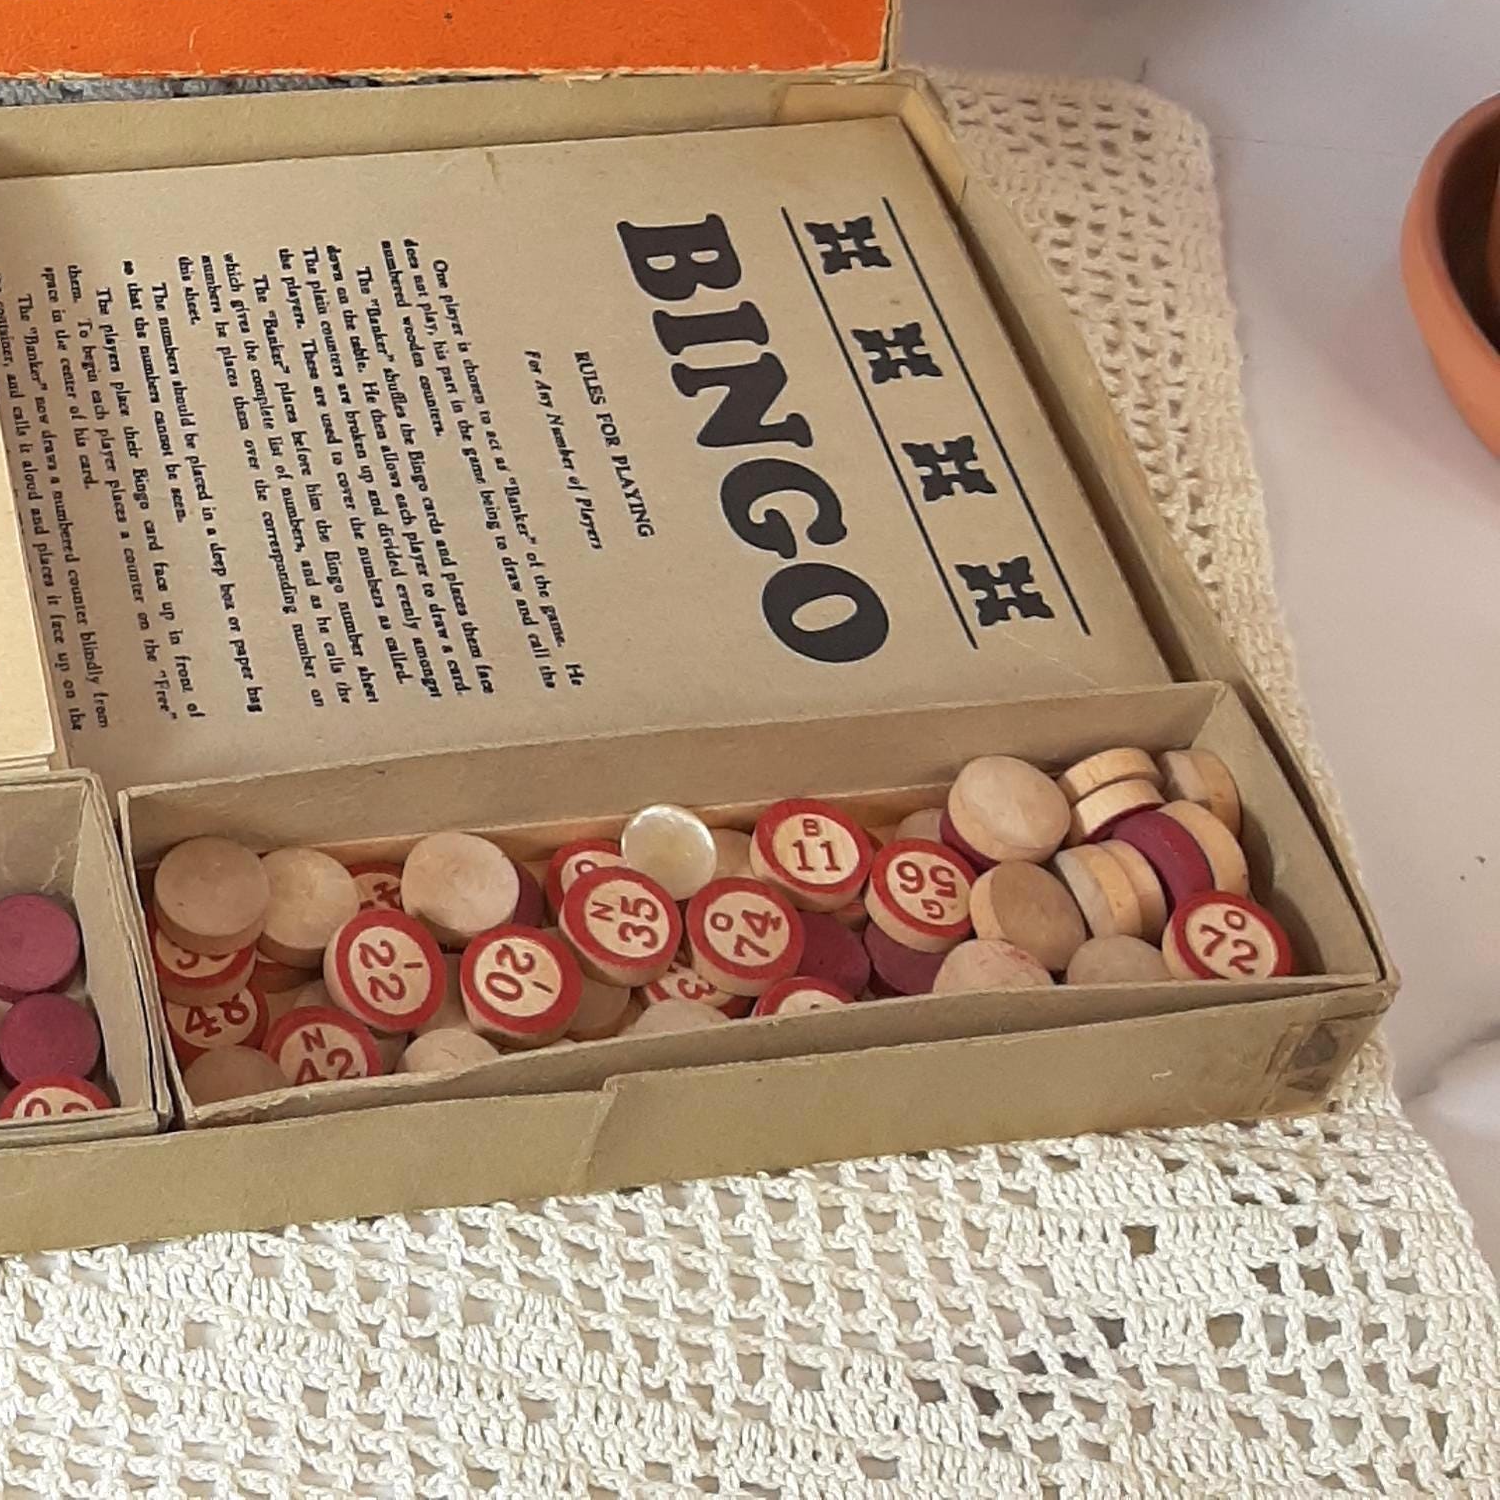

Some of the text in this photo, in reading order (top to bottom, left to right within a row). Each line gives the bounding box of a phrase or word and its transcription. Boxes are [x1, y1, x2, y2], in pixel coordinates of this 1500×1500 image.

[354, 264, 374, 295] The
[431, 258, 449, 289] One
[437, 293, 464, 336] player
[401, 314, 426, 368] wooden
[431, 339, 450, 361] his
[381, 366, 408, 419] shuffles
[436, 364, 458, 394] part
[461, 358, 485, 405] chosen
[449, 398, 466, 414] in
[478, 409, 492, 425] to
[398, 422, 416, 446] the
[455, 418, 475, 442] the
[484, 429, 503, 451] act
[573, 350, 656, 538] RULES FOR PLAYING
[616, 213, 889, 663] BINGO
[461, 446, 487, 485] game
[523, 349, 603, 550] For Any Number of Players
[406, 449, 429, 492] Bingo
[94, 286, 206, 718] The players place their Bingo card face up in front of
[420, 495, 446, 535] cards
[478, 488, 501, 530] being
[434, 538, 458, 567] and
[493, 534, 508, 551] to
[524, 551, 546, 568] of
[500, 555, 523, 592] draw
[532, 573, 552, 598] the
[440, 571, 469, 617] places
[514, 597, 540, 626] and
[459, 620, 483, 659] them
[526, 632, 551, 659] call
[473, 663, 495, 694] face
[537, 664, 557, 689] the
[563, 663, 586, 686] He
[802, 818, 823, 837] B
[791, 839, 841, 872] 11
[896, 860, 957, 899] 56
[617, 896, 660, 949] 35
[733, 909, 782, 958] 74
[1199, 924, 1259, 975] 72
[358, 940, 406, 1002] 22
[485, 943, 536, 1002] 20
[301, 1026, 326, 1052] N
